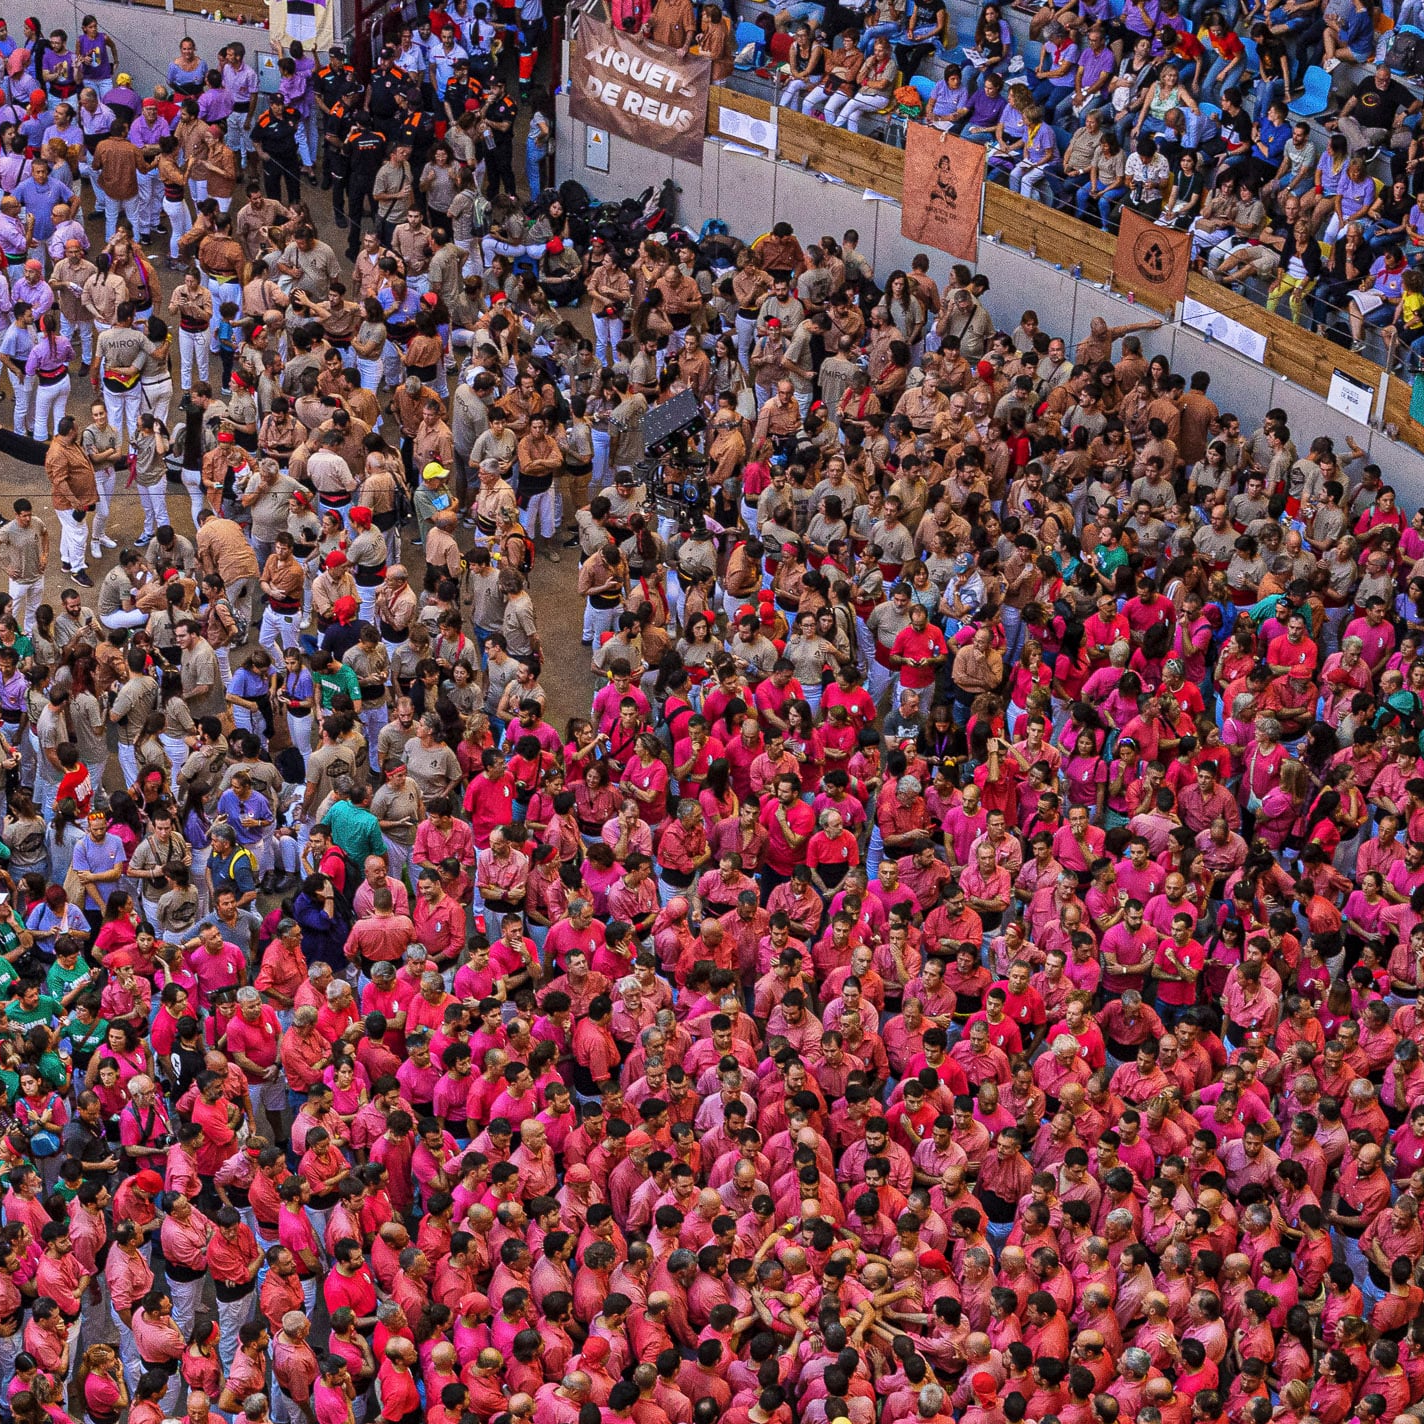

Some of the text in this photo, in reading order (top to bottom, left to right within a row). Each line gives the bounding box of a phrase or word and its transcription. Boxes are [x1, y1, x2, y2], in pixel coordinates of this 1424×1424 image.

[585, 43, 698, 99] XIQUETS
[584, 74, 695, 133] DE REUS
